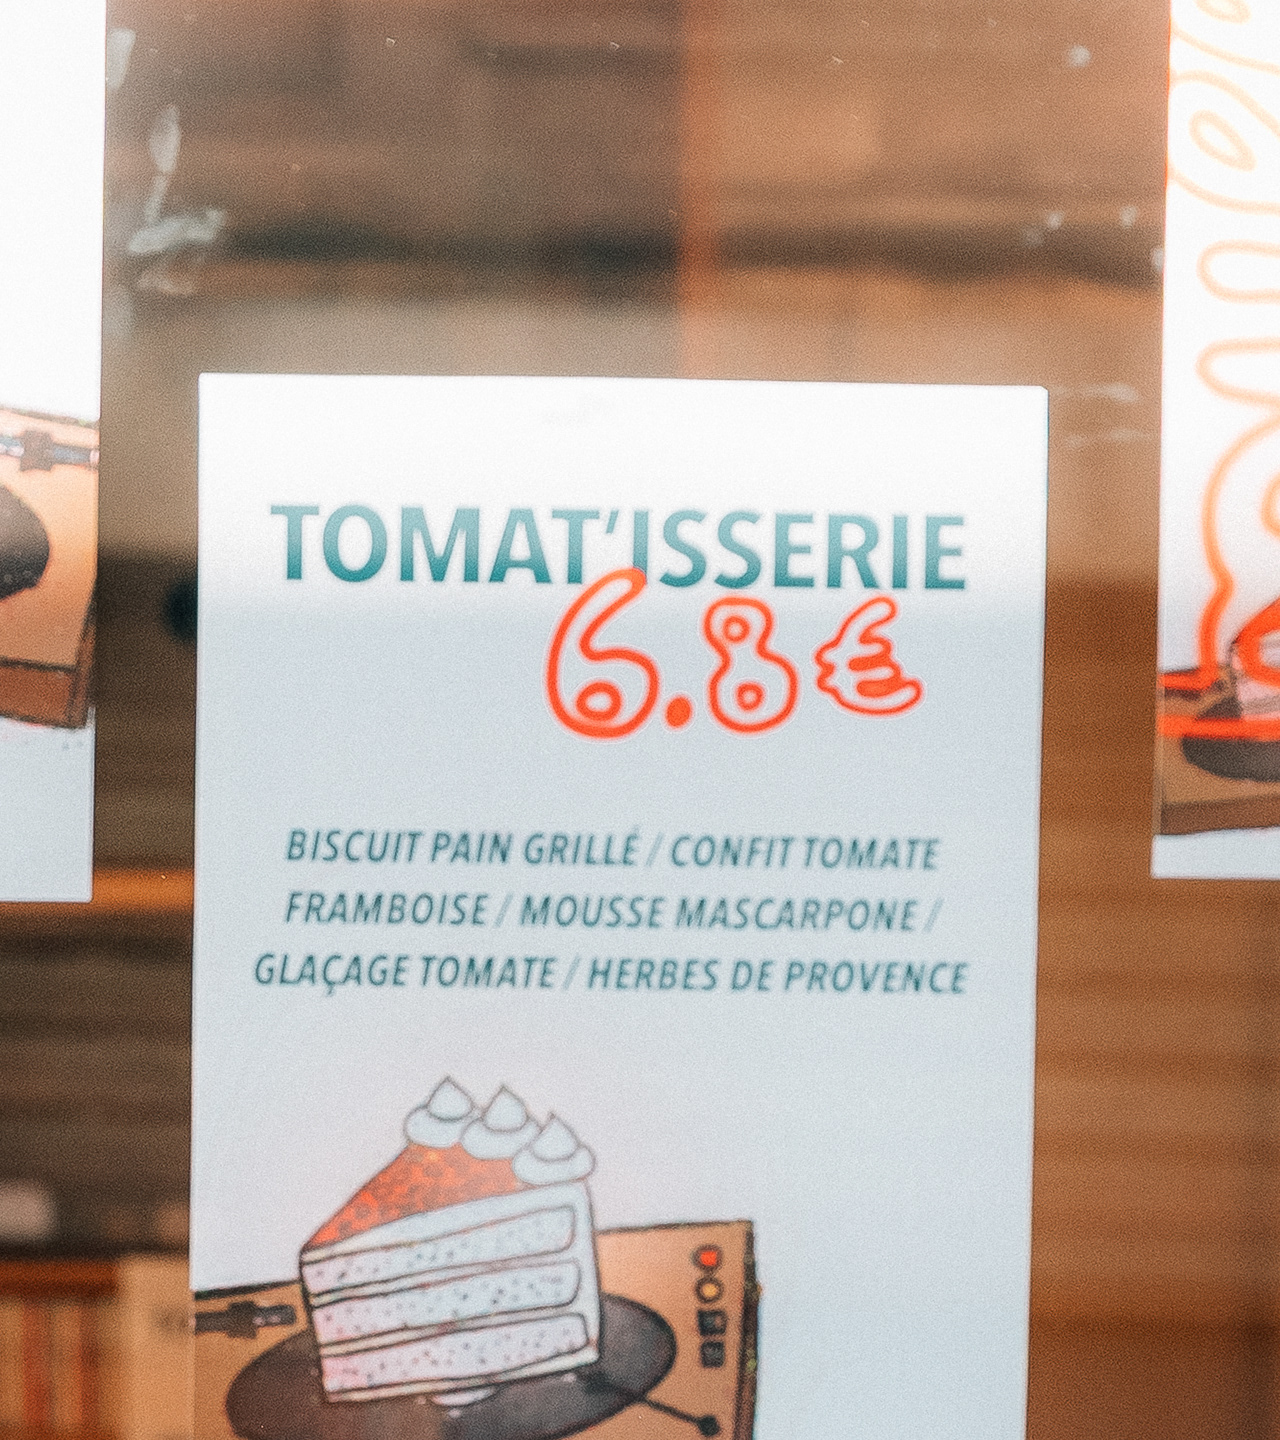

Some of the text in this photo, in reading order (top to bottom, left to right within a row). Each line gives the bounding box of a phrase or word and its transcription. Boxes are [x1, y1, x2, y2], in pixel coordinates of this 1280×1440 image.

[268, 502, 969, 594] TOMAT'ISSERIE
[285, 827, 425, 865] BISCUIT
[428, 829, 514, 865] PAIN
[522, 824, 640, 868] GRILLÉ
[669, 833, 796, 869] CONFIT
[802, 835, 940, 872] TOMATE
[284, 889, 490, 927] FRAMBOISE
[518, 893, 666, 929] MOUSSE
[674, 896, 919, 933] MASCARPONE
[253, 951, 411, 997] GLAÇAGE
[418, 954, 558, 989] TOMATE
[586, 956, 722, 992] HERBES
[728, 958, 776, 993] DE
[783, 959, 970, 996] PROVENCE
